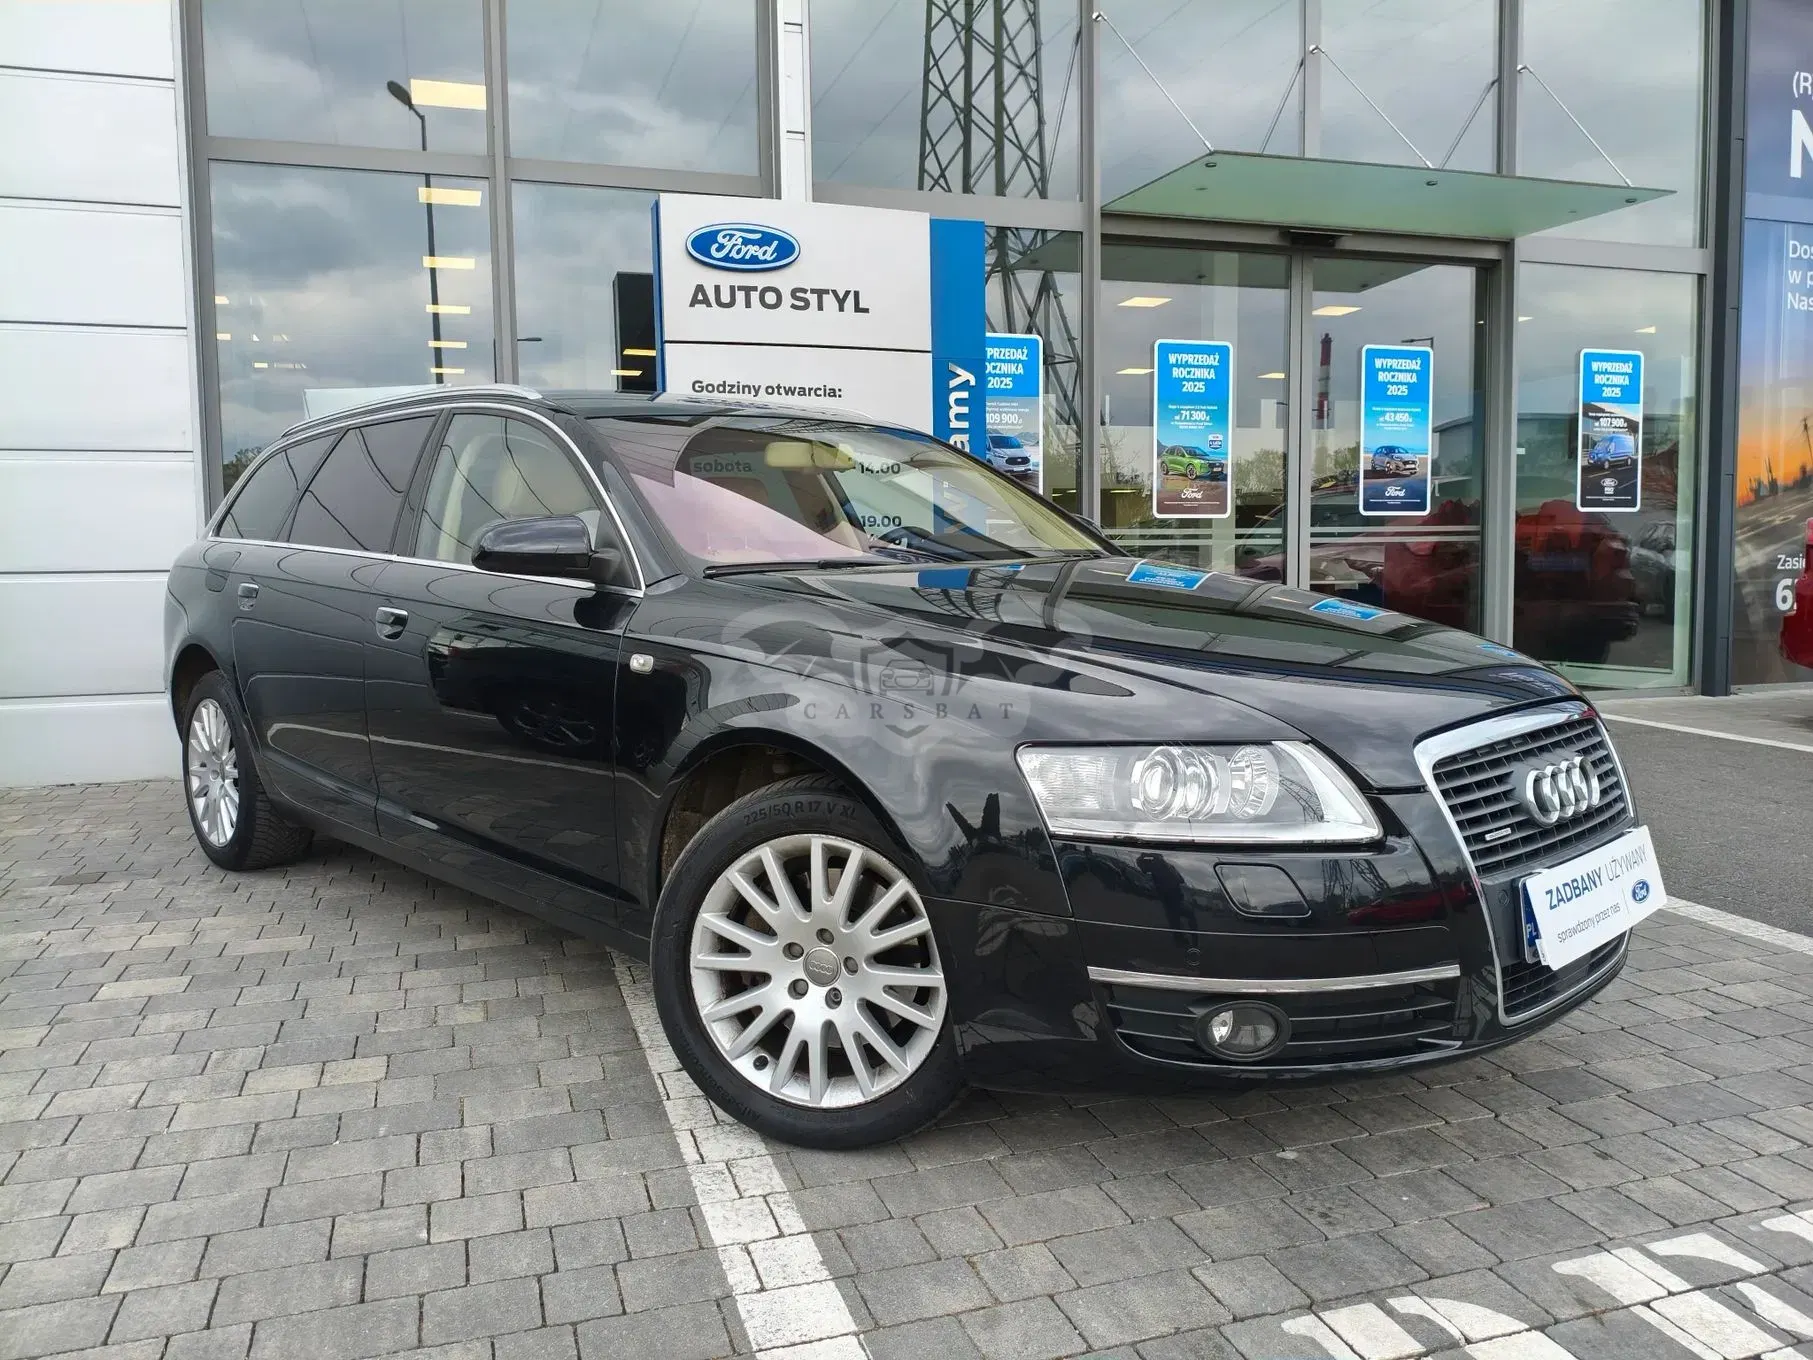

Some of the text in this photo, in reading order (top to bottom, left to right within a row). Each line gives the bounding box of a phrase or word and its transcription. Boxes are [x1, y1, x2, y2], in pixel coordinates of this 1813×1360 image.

[710, 230, 779, 261] Ford
[1788, 269, 1802, 285] w
[689, 284, 870, 314] AUTO STYL
[1168, 352, 1219, 366] WYPRZEDAŻ
[1374, 357, 1421, 370] WYPRZEDAŻ
[1172, 366, 1216, 380] ROCZNIKA
[1591, 360, 1633, 374] WYPRZEDAŻ
[987, 376, 1013, 389] 2025
[1378, 371, 1417, 383] ROCZNIKA
[1594, 374, 1630, 386] ROCZNIKA
[691, 379, 842, 398] Godziny otwarcia:
[1181, 380, 1206, 393] 2025
[1386, 384, 1408, 396] 2025
[1601, 386, 1622, 398] 2025
[693, 458, 752, 473] sobota
[1181, 487, 1203, 499] Ford
[1385, 486, 1405, 497] Ford
[861, 515, 902, 528] 19.00
[1776, 553, 1806, 570] Zasi
[1545, 843, 1649, 911] ZADBANY UŻYWANY
[1557, 901, 1621, 943] sprawdzony przez nas
[1526, 922, 1537, 938] PL
